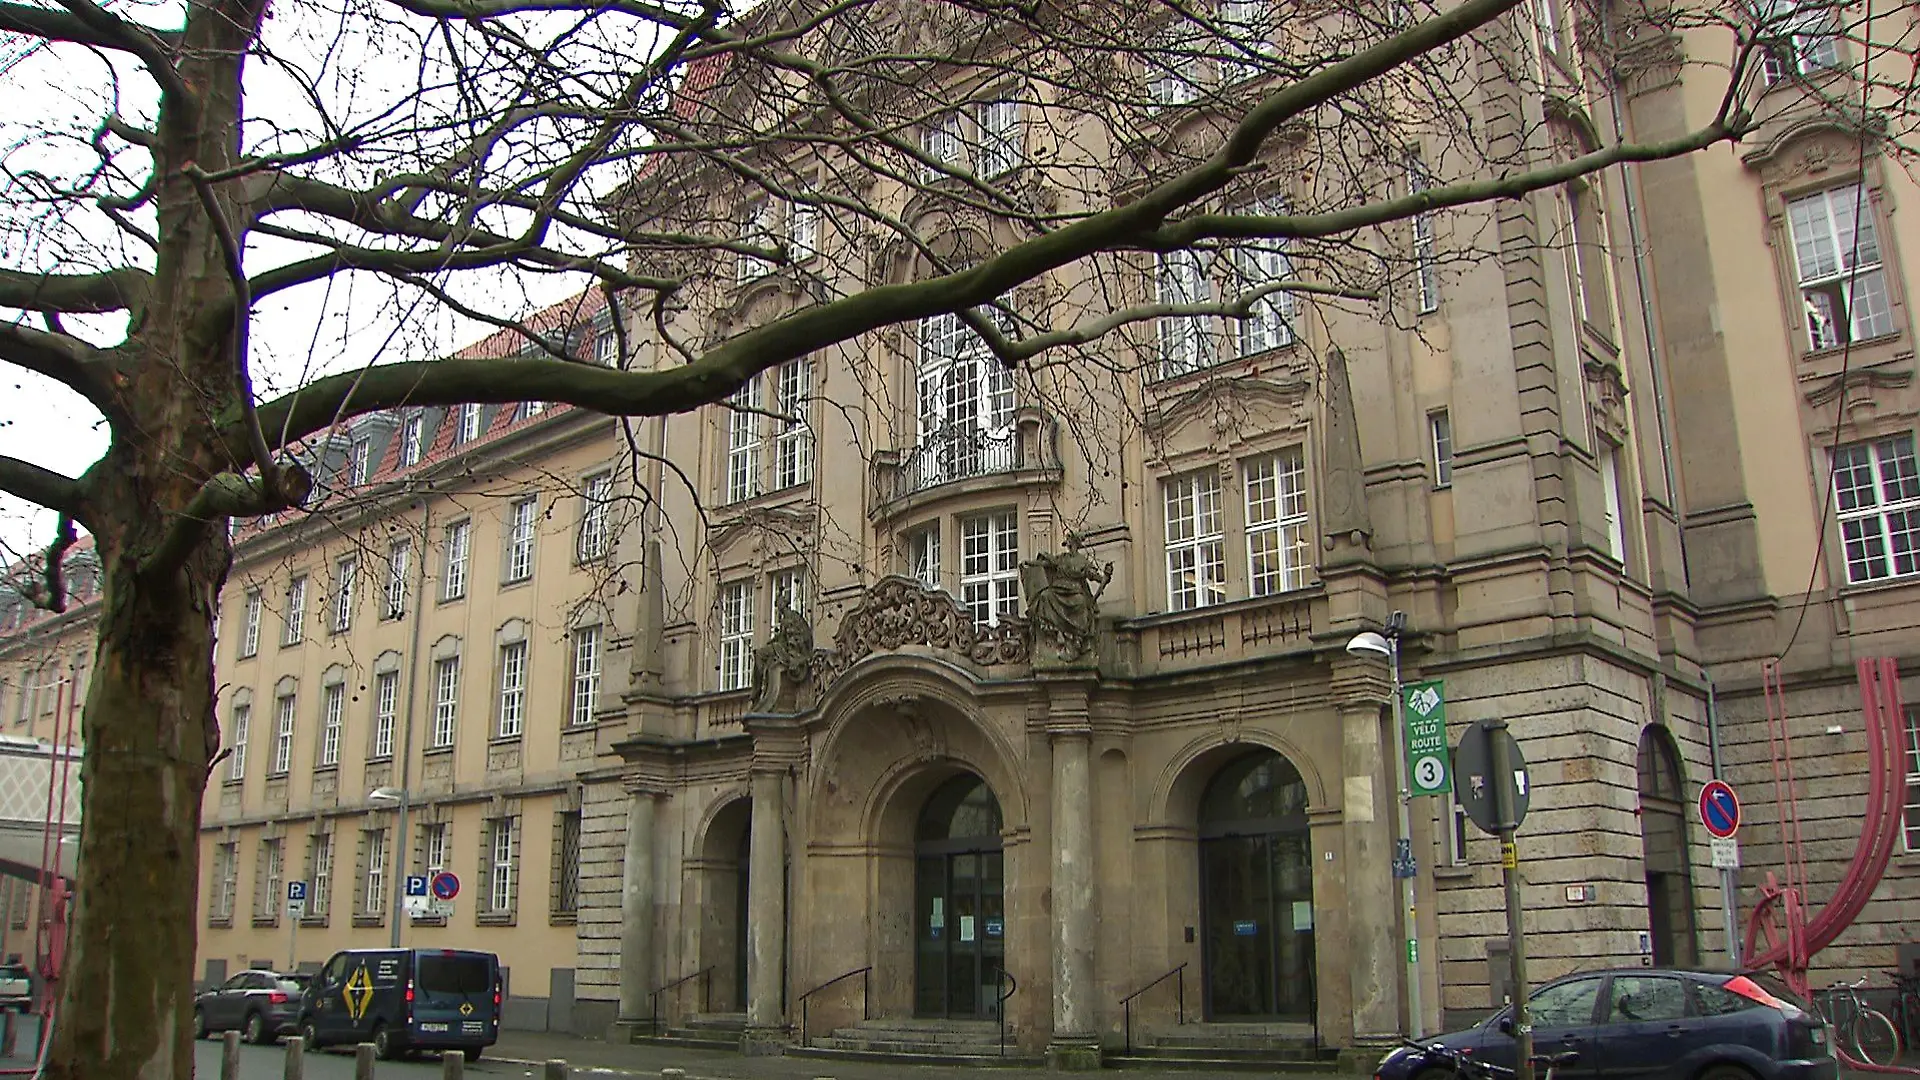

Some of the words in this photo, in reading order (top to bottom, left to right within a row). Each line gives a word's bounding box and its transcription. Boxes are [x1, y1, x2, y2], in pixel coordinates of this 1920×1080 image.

[1413, 724, 1437, 735] VELO
[1411, 736, 1442, 749] ROUTE
[1422, 762, 1435, 782] 3
[290, 884, 301, 898] P
[410, 878, 422, 894] P
